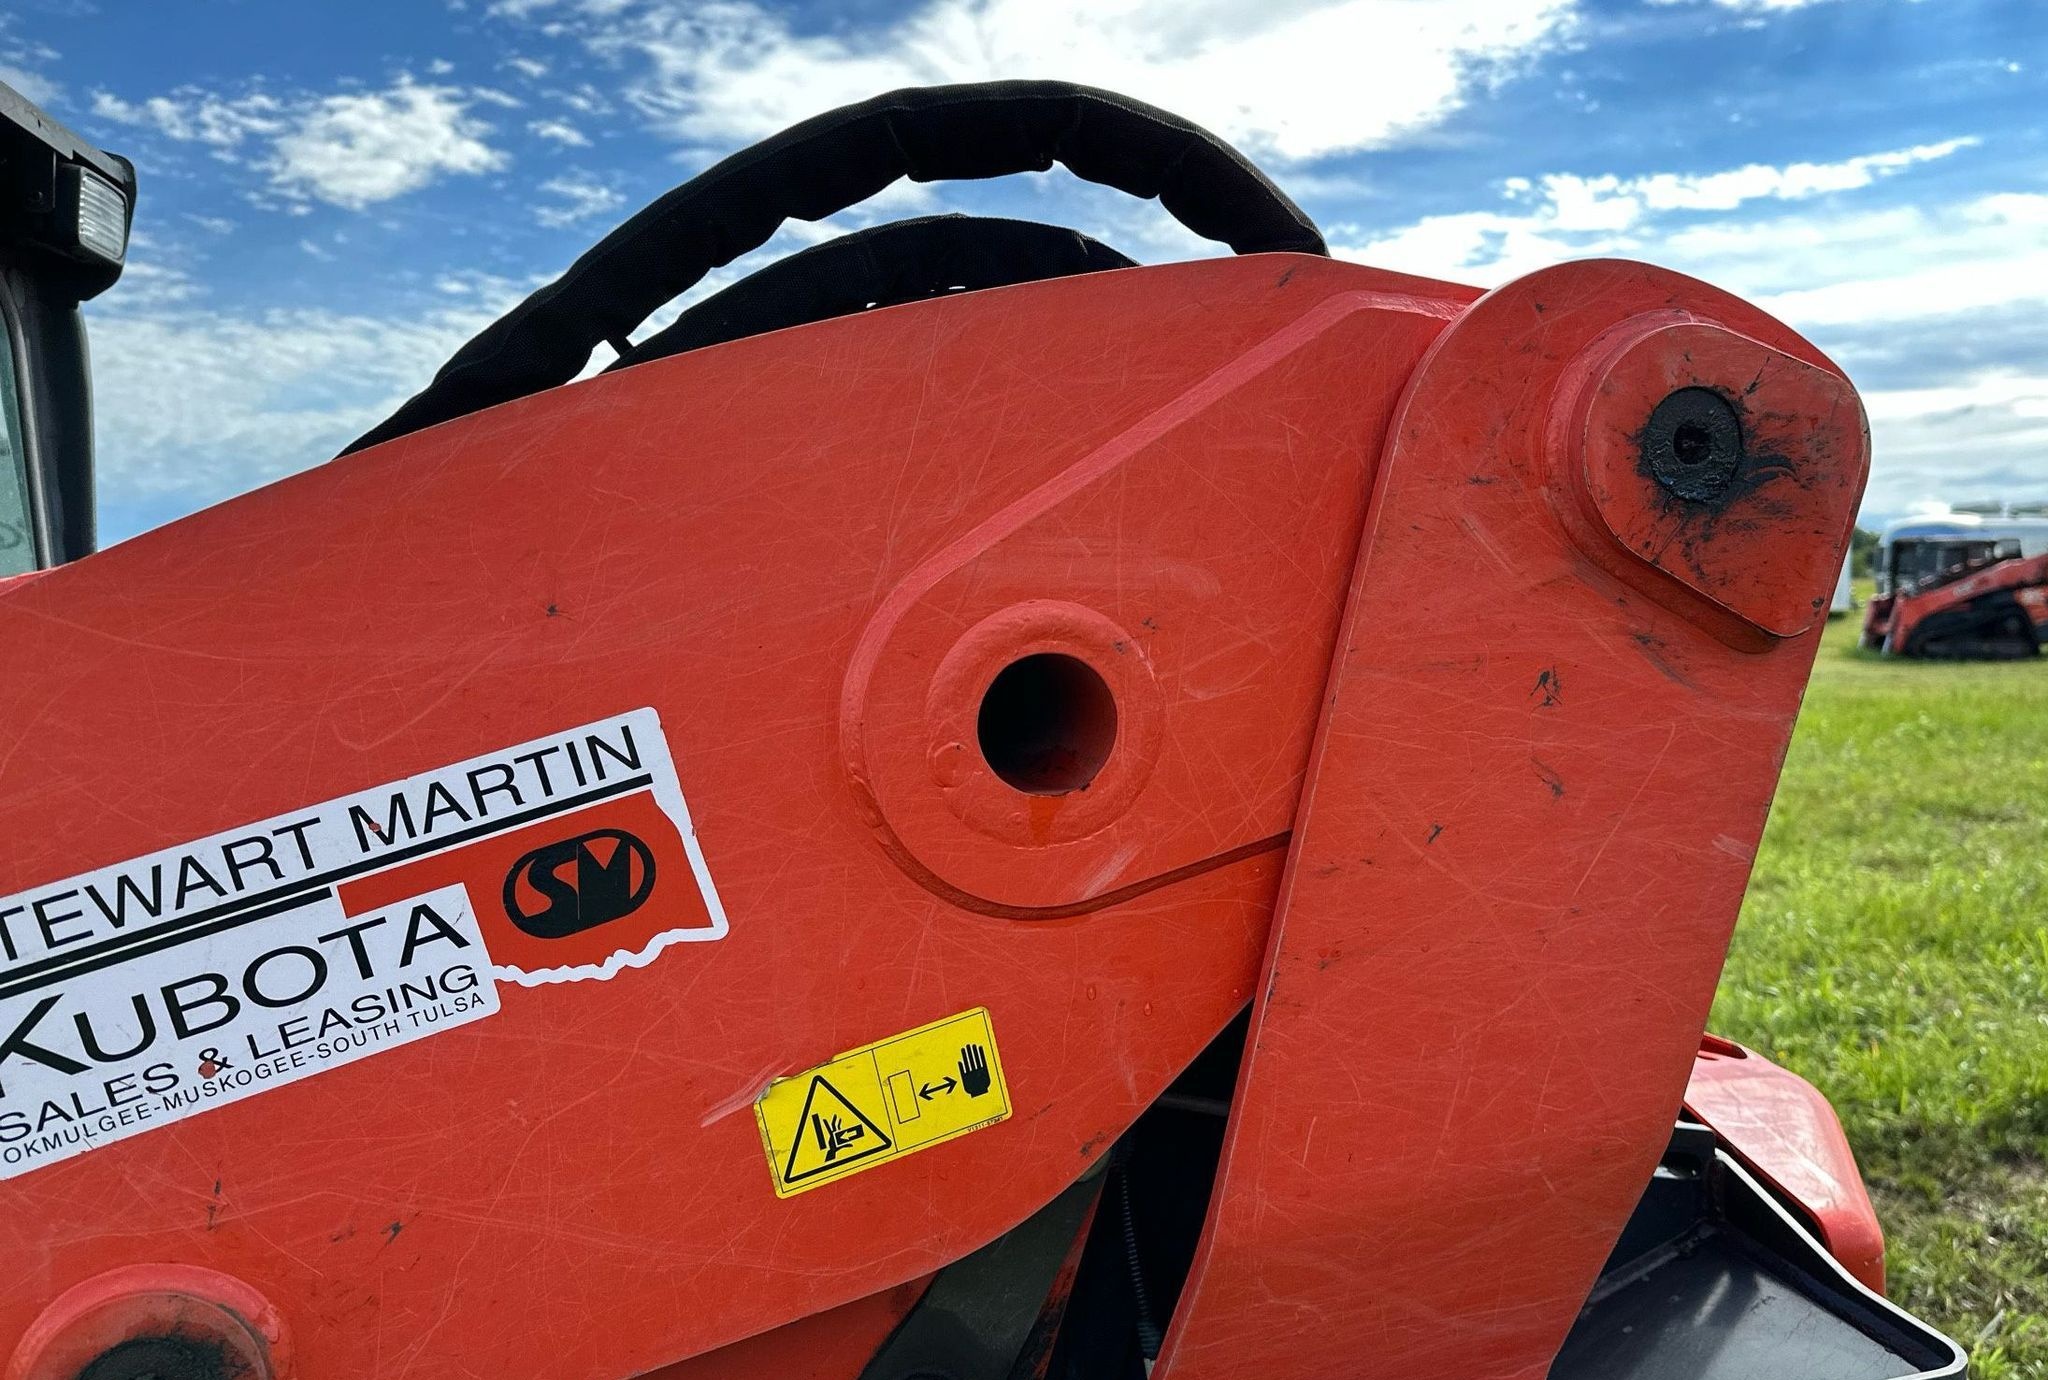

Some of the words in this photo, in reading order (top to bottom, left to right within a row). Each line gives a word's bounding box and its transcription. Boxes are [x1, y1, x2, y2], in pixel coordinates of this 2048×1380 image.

[348, 725, 642, 853] MARTIN
[0, 903, 471, 1098] KUBOTA
[0, 1063, 179, 1142] SALES
[199, 1047, 234, 1078] &
[247, 964, 479, 1060] LEASING
[4, 1020, 401, 1164] OKMULGEE-MUSKOGEE-SOUTH
[407, 992, 485, 1027] TULSA
